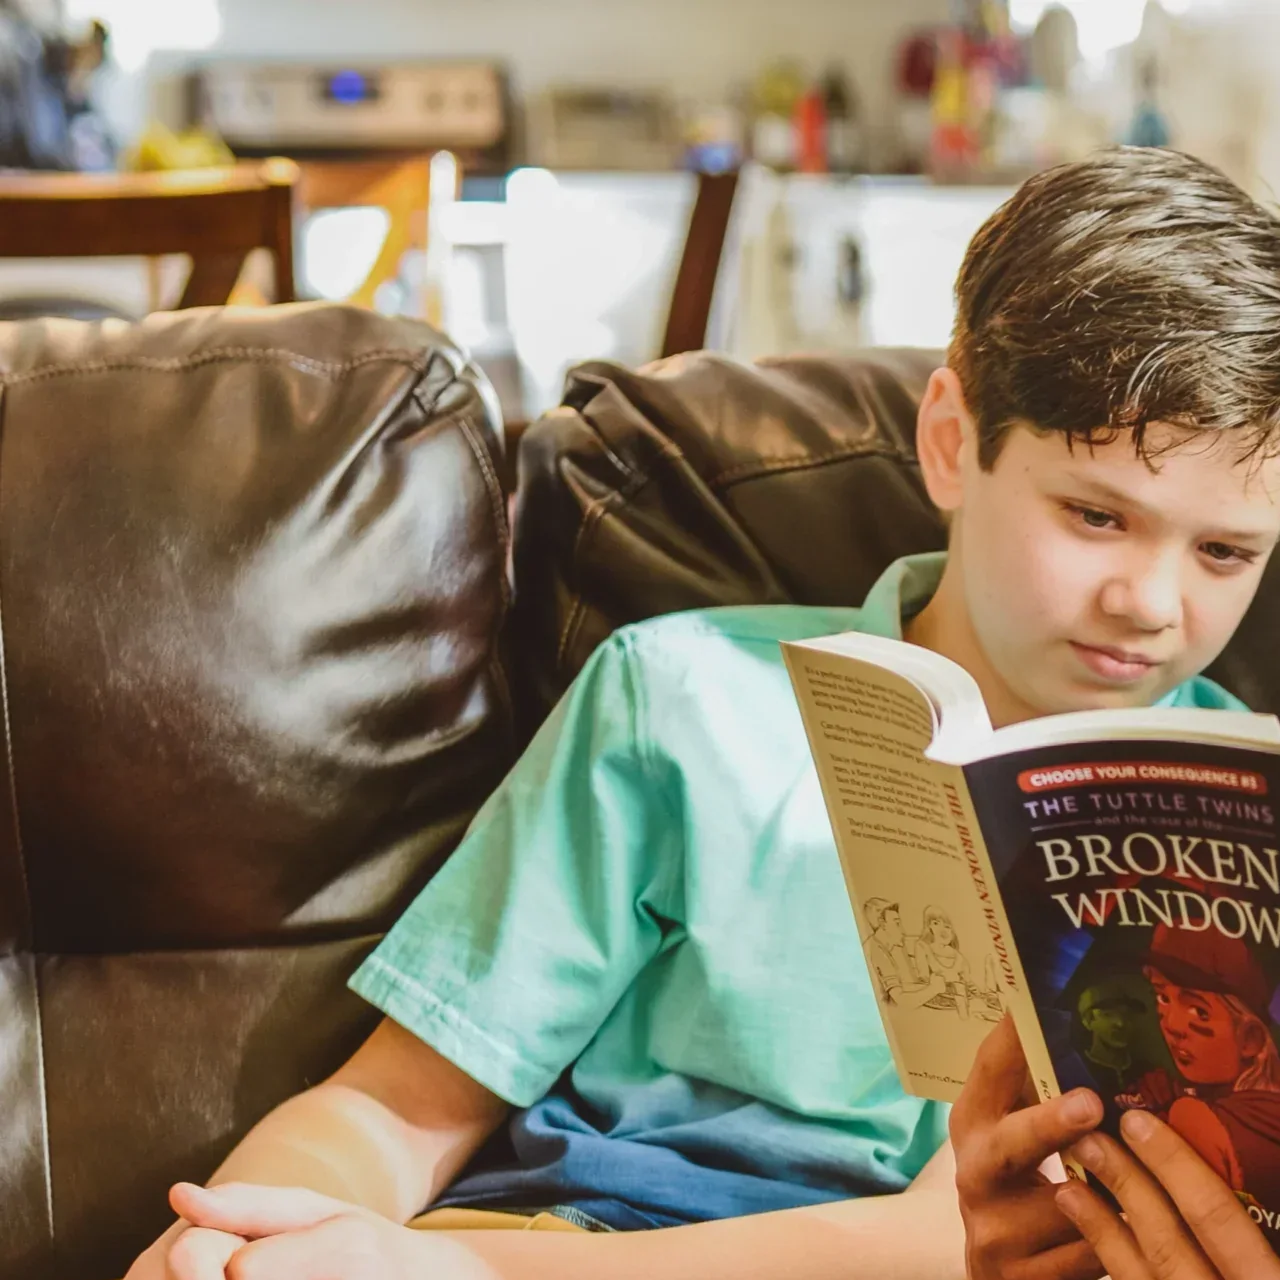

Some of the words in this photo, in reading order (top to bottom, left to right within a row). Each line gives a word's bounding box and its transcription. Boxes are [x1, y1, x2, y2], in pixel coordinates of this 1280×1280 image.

[1030, 767, 1094, 787] CHOOSE
[1095, 765, 1138, 780] YOUR
[1138, 765, 1239, 787] CONSEQUENCE
[1022, 795, 1079, 819] THE
[1089, 792, 1188, 812] TUTTLE
[1197, 795, 1275, 826] TWINS
[943, 781, 966, 820] THE
[957, 823, 994, 905] BROKEN
[984, 907, 1019, 992] WINDOW
[1036, 832, 1280, 895] BROKEN
